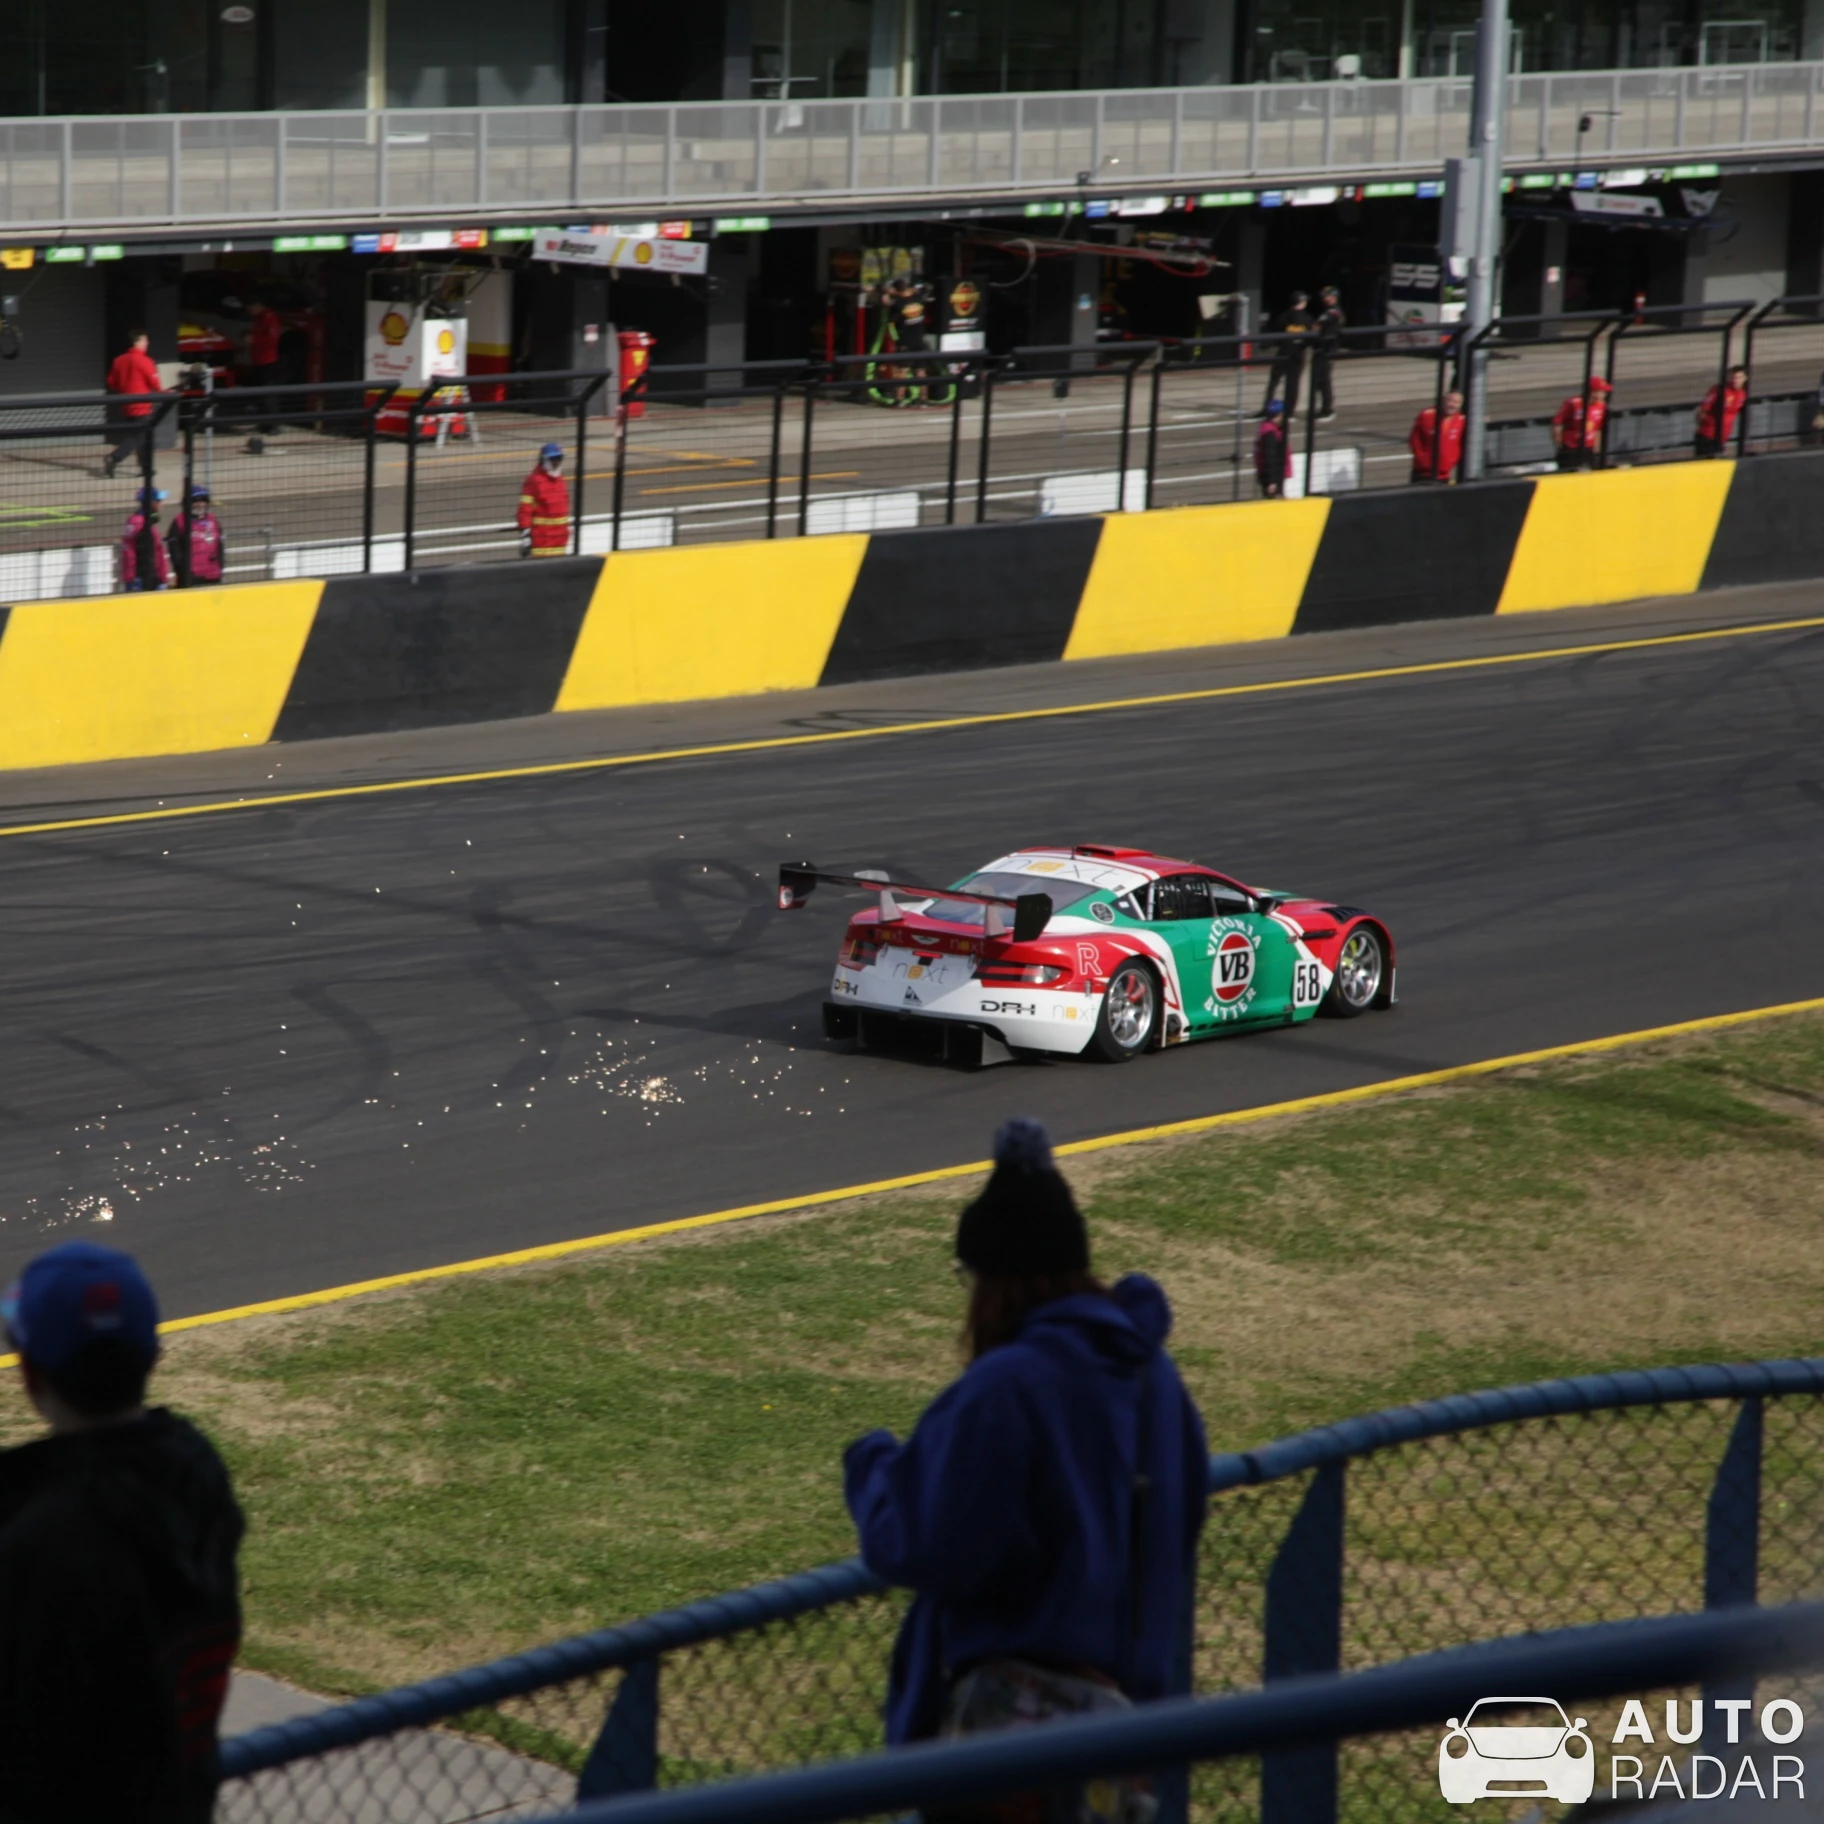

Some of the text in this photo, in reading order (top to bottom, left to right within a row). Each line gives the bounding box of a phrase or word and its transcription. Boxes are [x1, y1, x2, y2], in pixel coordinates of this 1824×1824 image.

[1207, 917, 1262, 956] VICTORIA
[891, 963, 949, 985] next
[1076, 942, 1103, 976] R
[1220, 951, 1250, 983] VB
[1296, 963, 1320, 1003] 58
[1052, 1003, 1097, 1023] next
[1203, 986, 1257, 1020] BITTER
